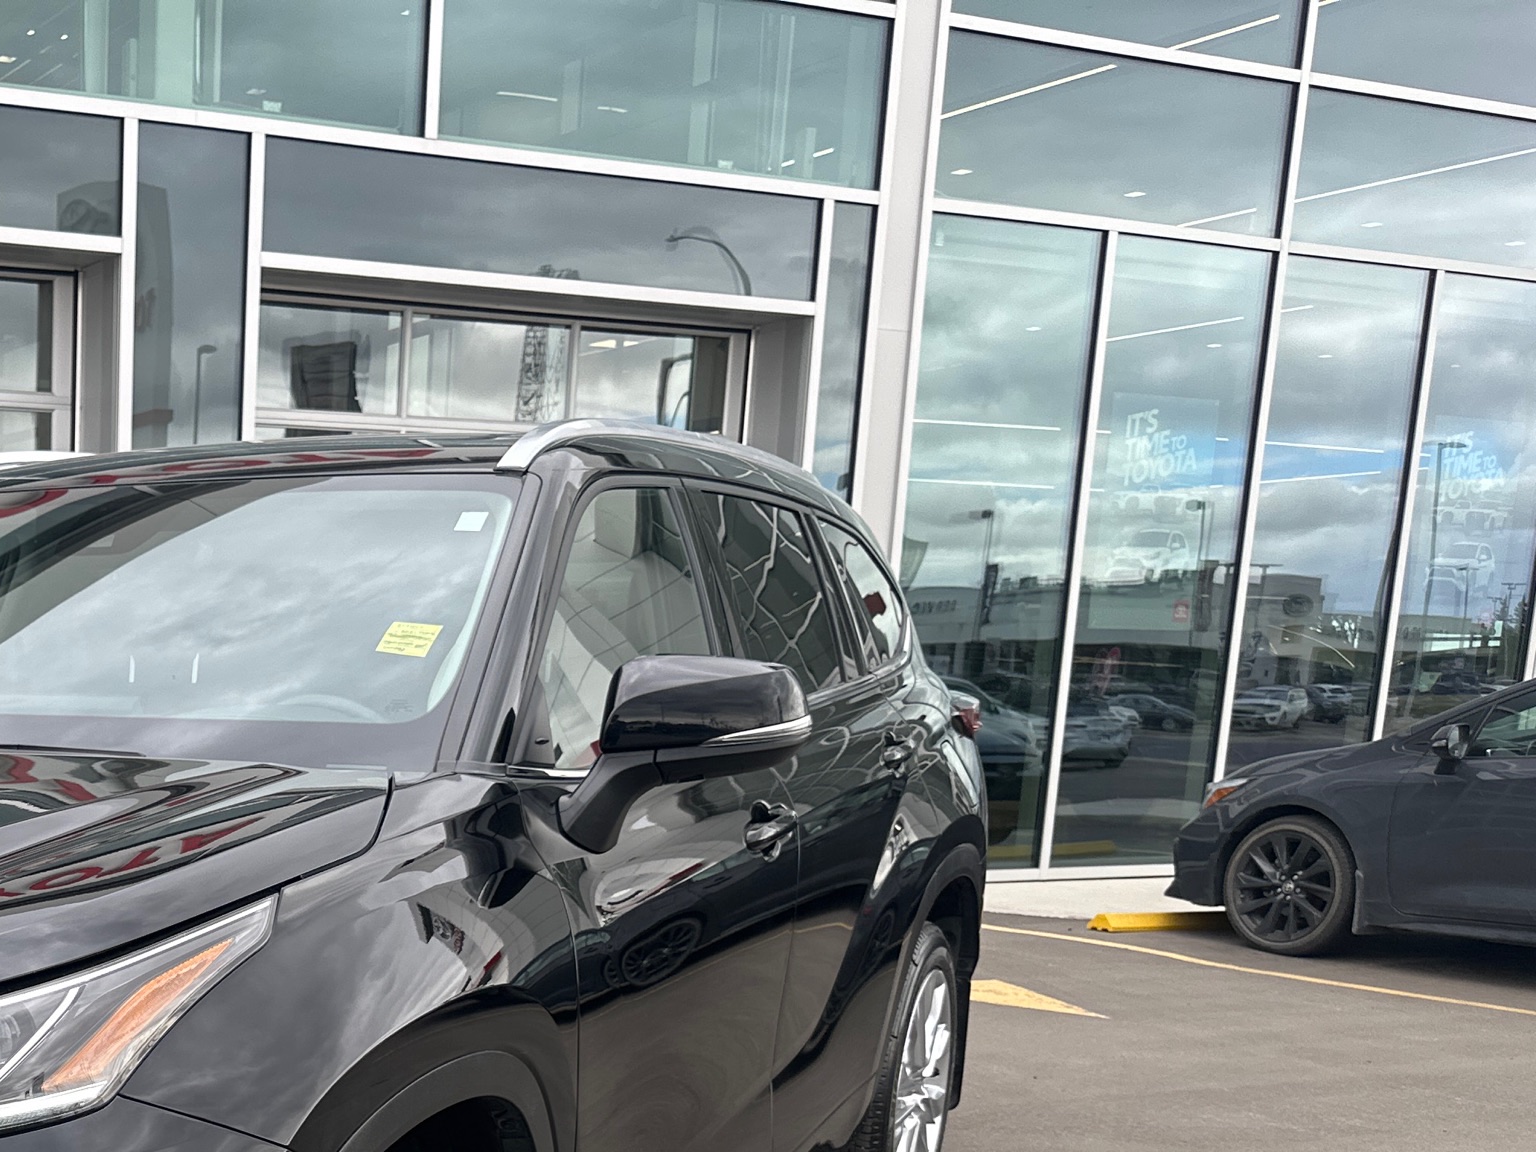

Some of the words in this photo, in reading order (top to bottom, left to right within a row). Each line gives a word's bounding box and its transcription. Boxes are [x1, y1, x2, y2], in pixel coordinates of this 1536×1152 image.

[1126, 408, 1159, 439] IT'S
[1125, 429, 1171, 461] TIME
[1171, 434, 1187, 451] TO
[1122, 447, 1197, 486] TOYOTA
[1443, 450, 1483, 480] TIME
[1483, 455, 1497, 469] TO
